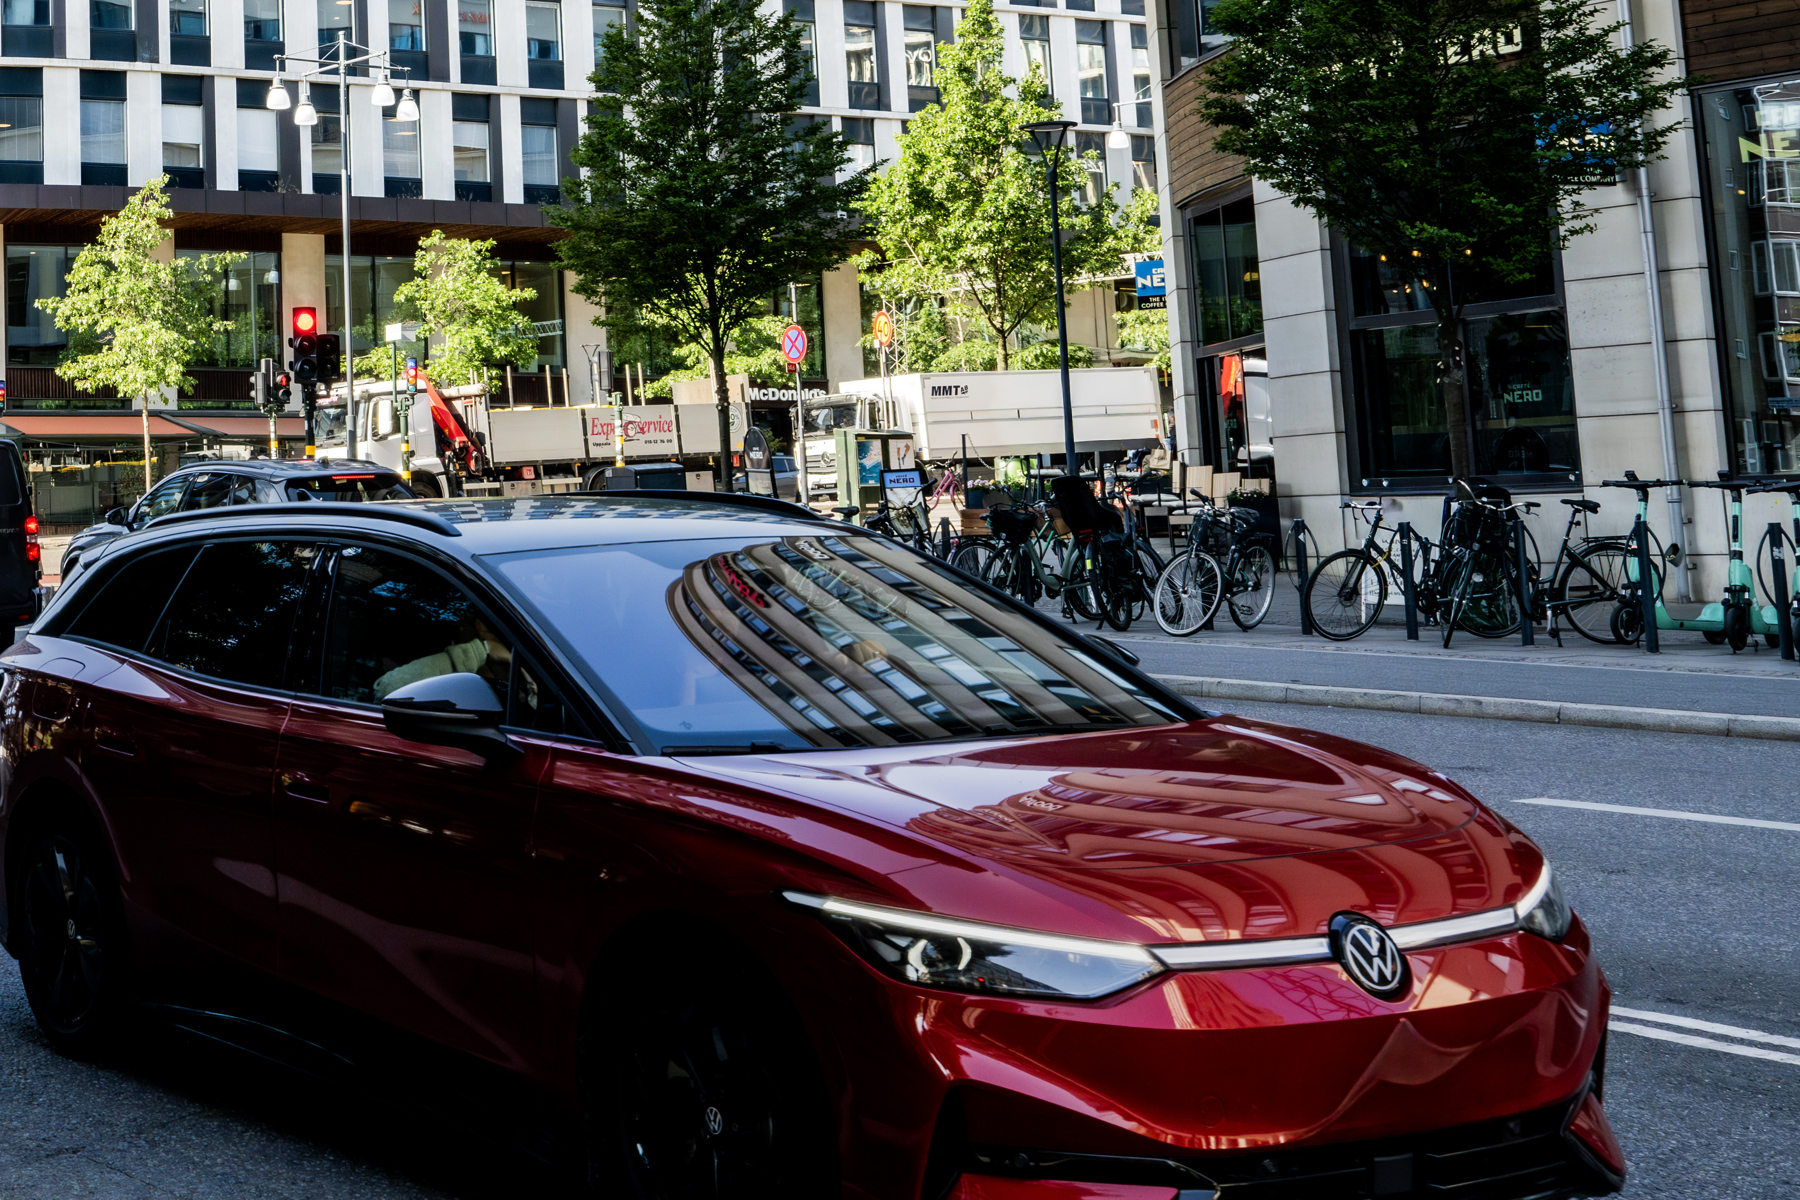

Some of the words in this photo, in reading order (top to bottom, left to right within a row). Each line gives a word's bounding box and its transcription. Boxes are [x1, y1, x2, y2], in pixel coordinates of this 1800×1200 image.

[1141, 301, 1164, 309] COFFEE
[877, 320, 890, 337] 40
[931, 385, 960, 396] MMT
[1503, 389, 1543, 403] NERO
